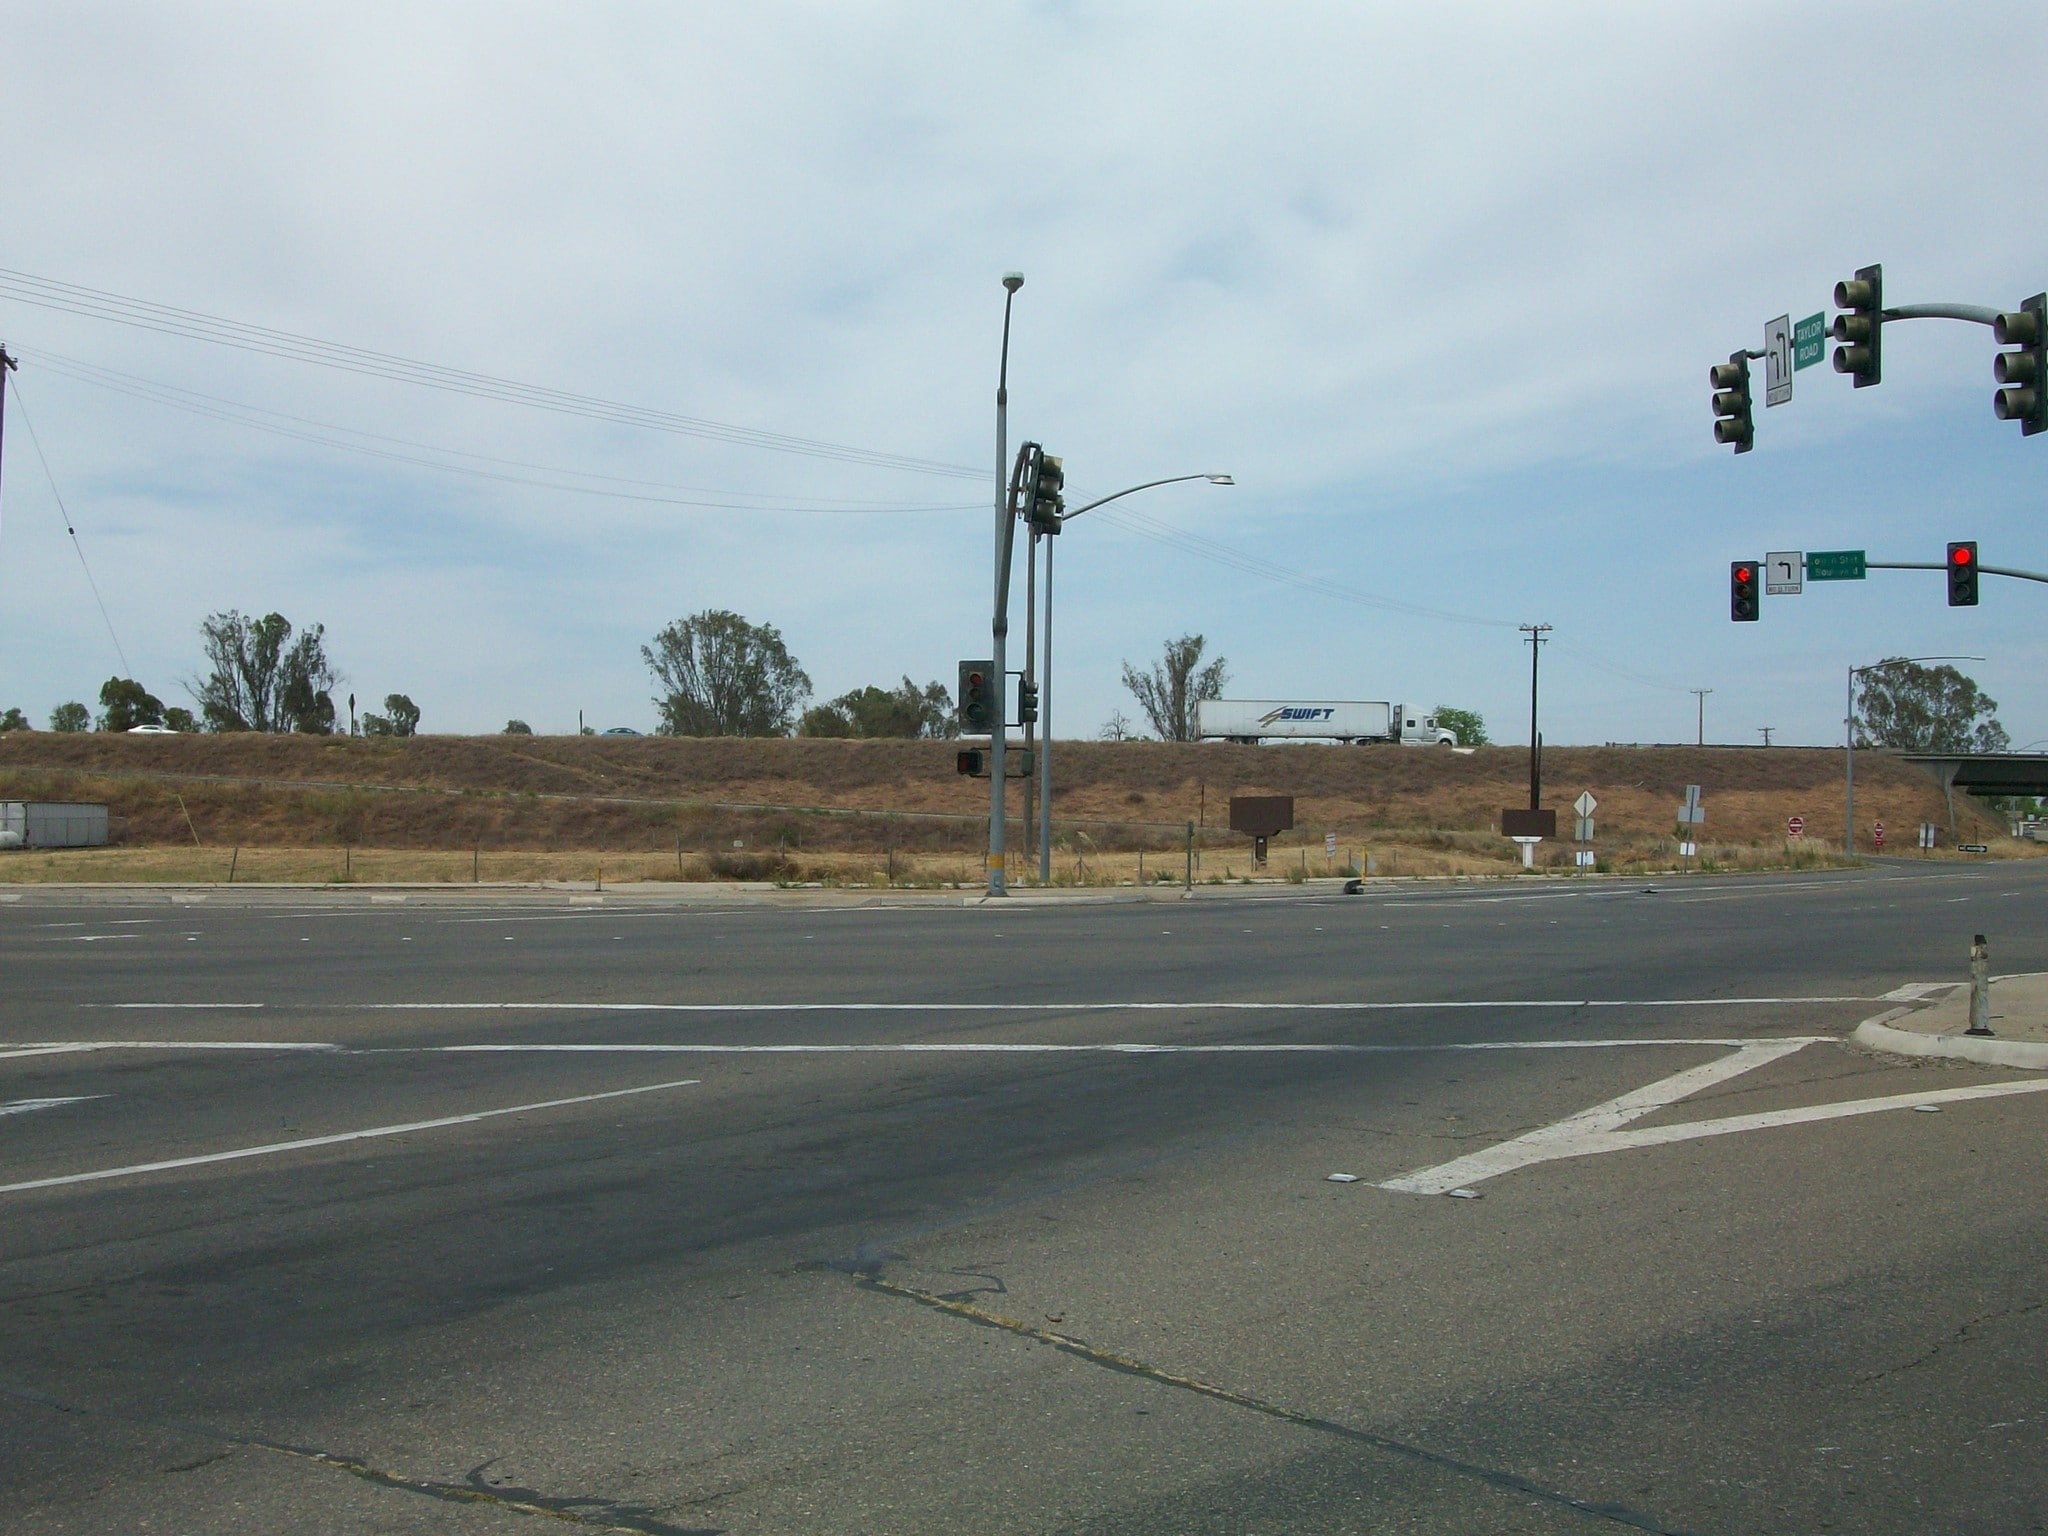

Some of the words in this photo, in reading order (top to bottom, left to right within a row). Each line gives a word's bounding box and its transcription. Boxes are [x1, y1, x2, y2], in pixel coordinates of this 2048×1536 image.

[1797, 321, 1821, 342] TAYLOR
[1800, 343, 1819, 361] ROAD
[1280, 708, 1335, 719] SWIFT
